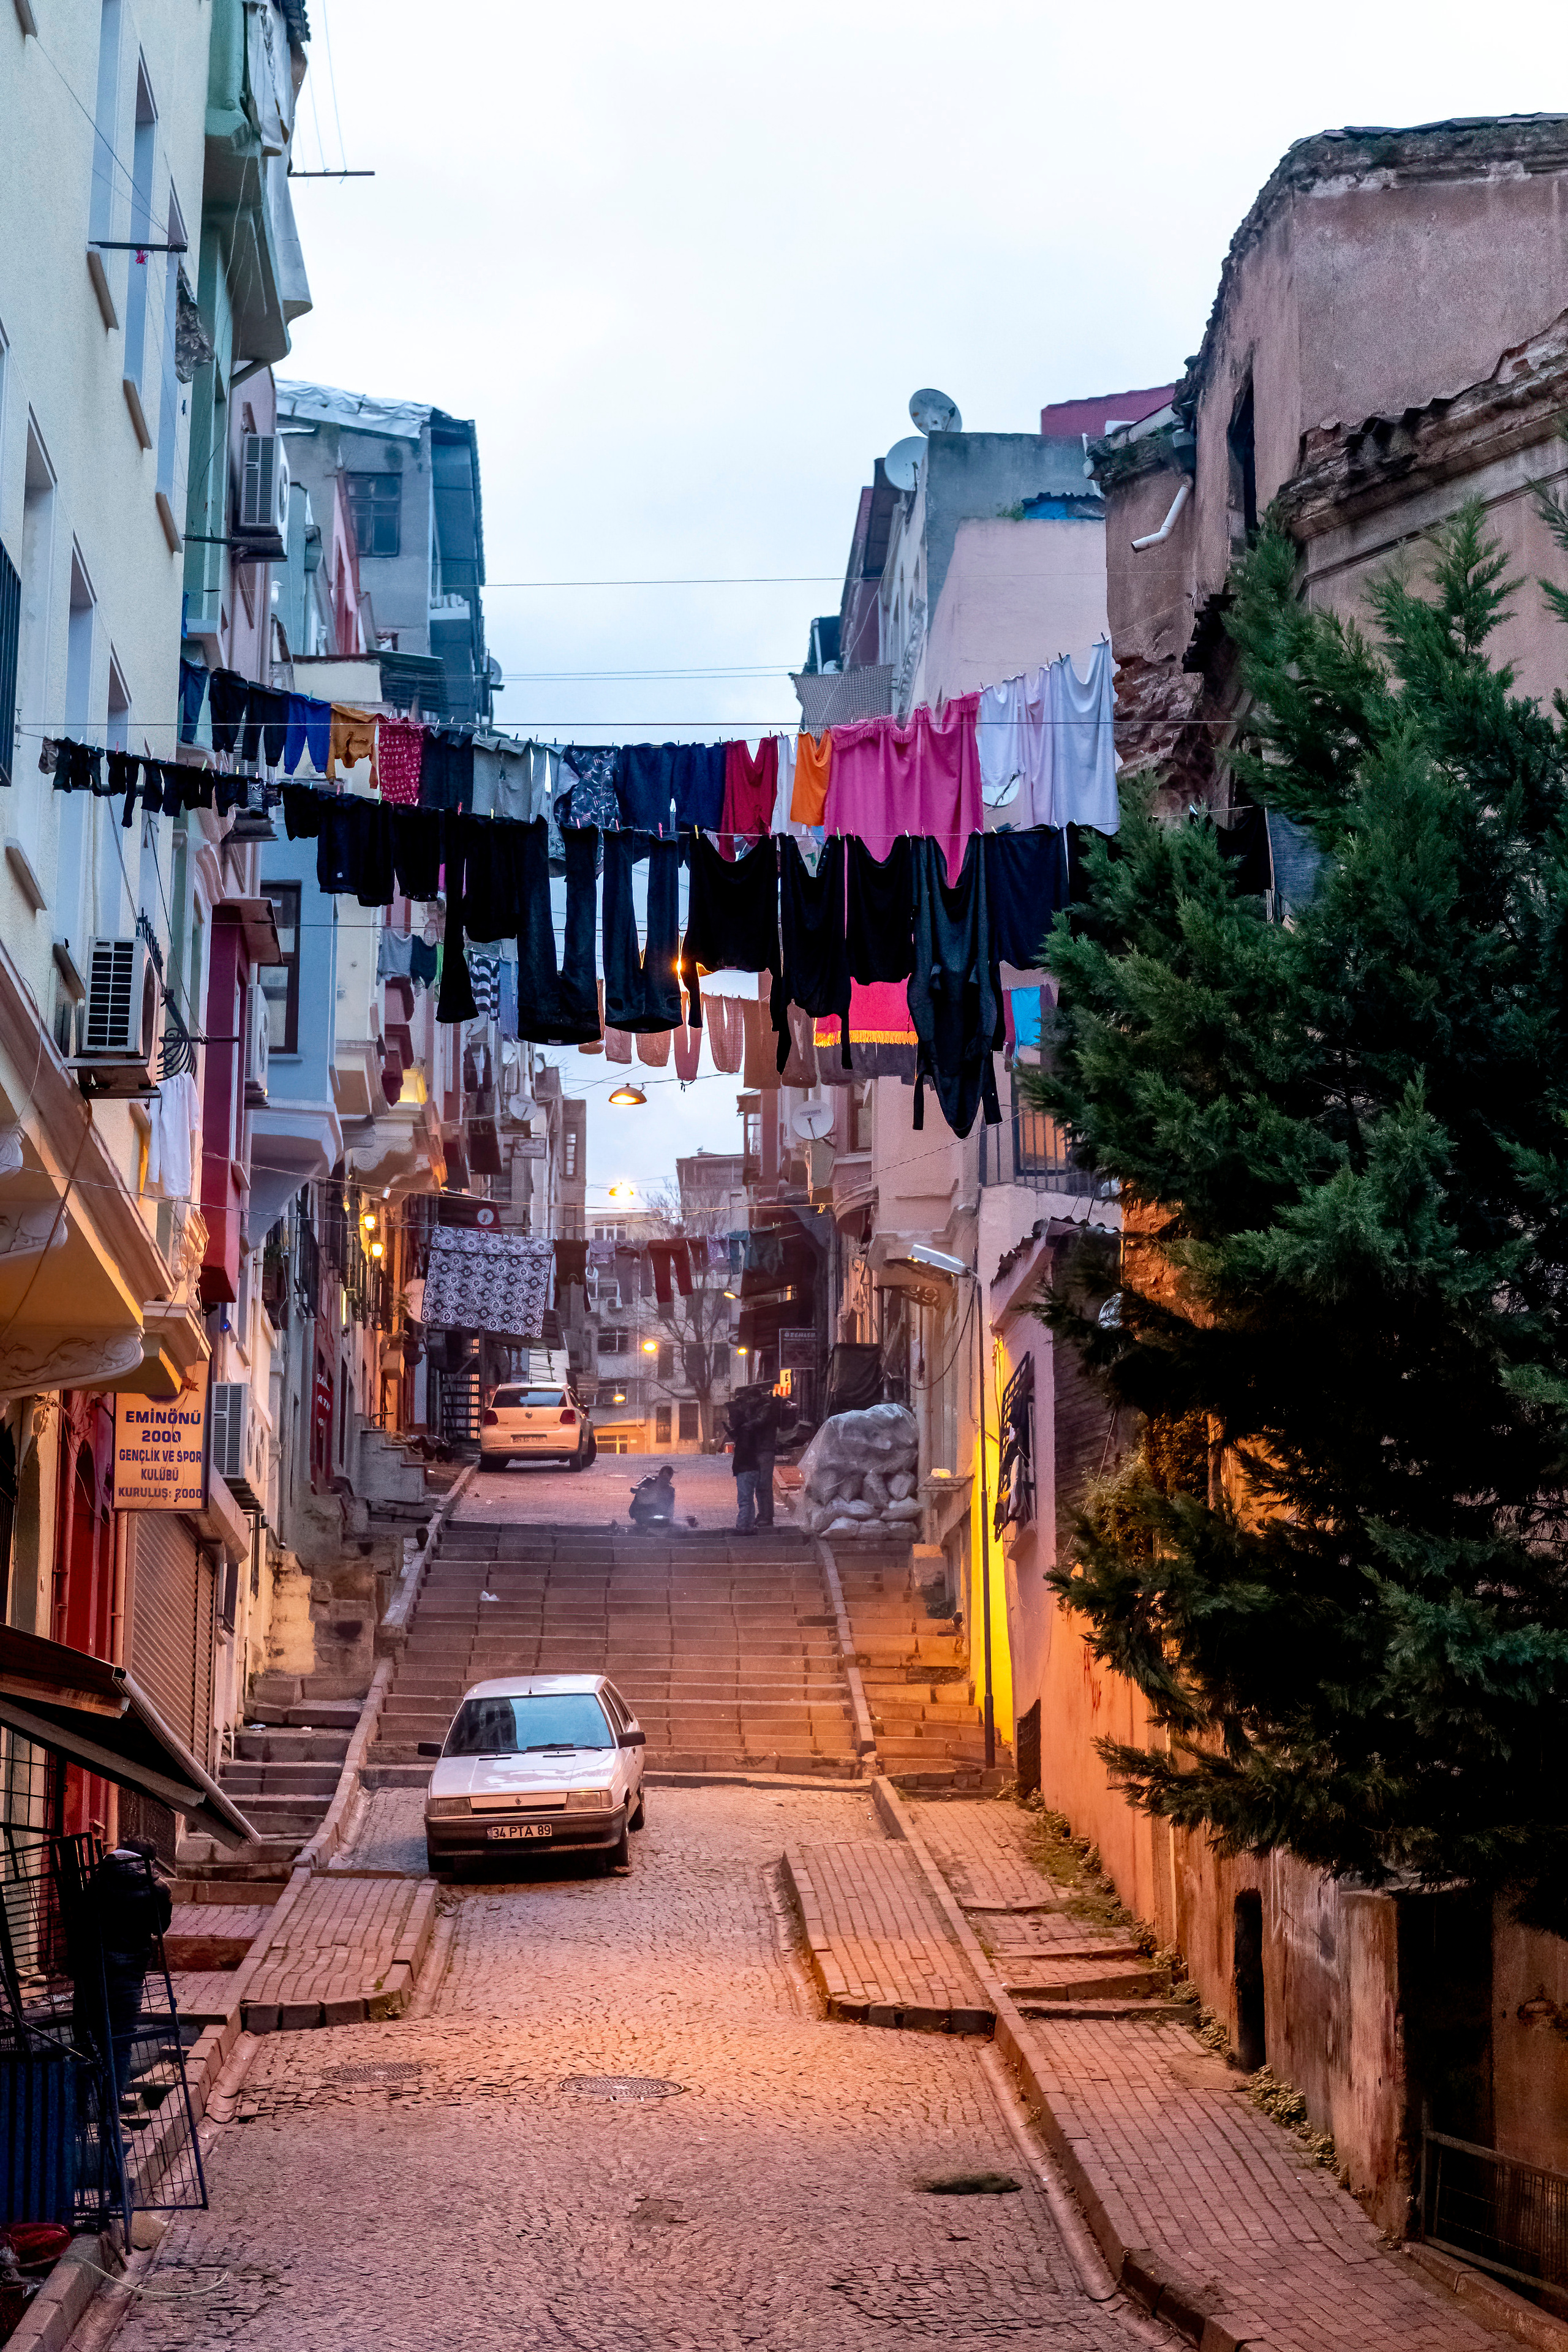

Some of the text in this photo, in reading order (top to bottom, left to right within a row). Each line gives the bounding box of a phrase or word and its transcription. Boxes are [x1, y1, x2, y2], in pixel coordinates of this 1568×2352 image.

[126, 1408, 201, 1425] EMİNÖNÜ
[141, 1430, 181, 1442] 2000
[119, 1447, 202, 1464] GENÇLİK VE SPOR
[141, 1466, 179, 1481] KULÜBÜ
[118, 1487, 203, 1500] KURULUŞ: 2000
[492, 1825, 551, 1838] 34 PTA 89
